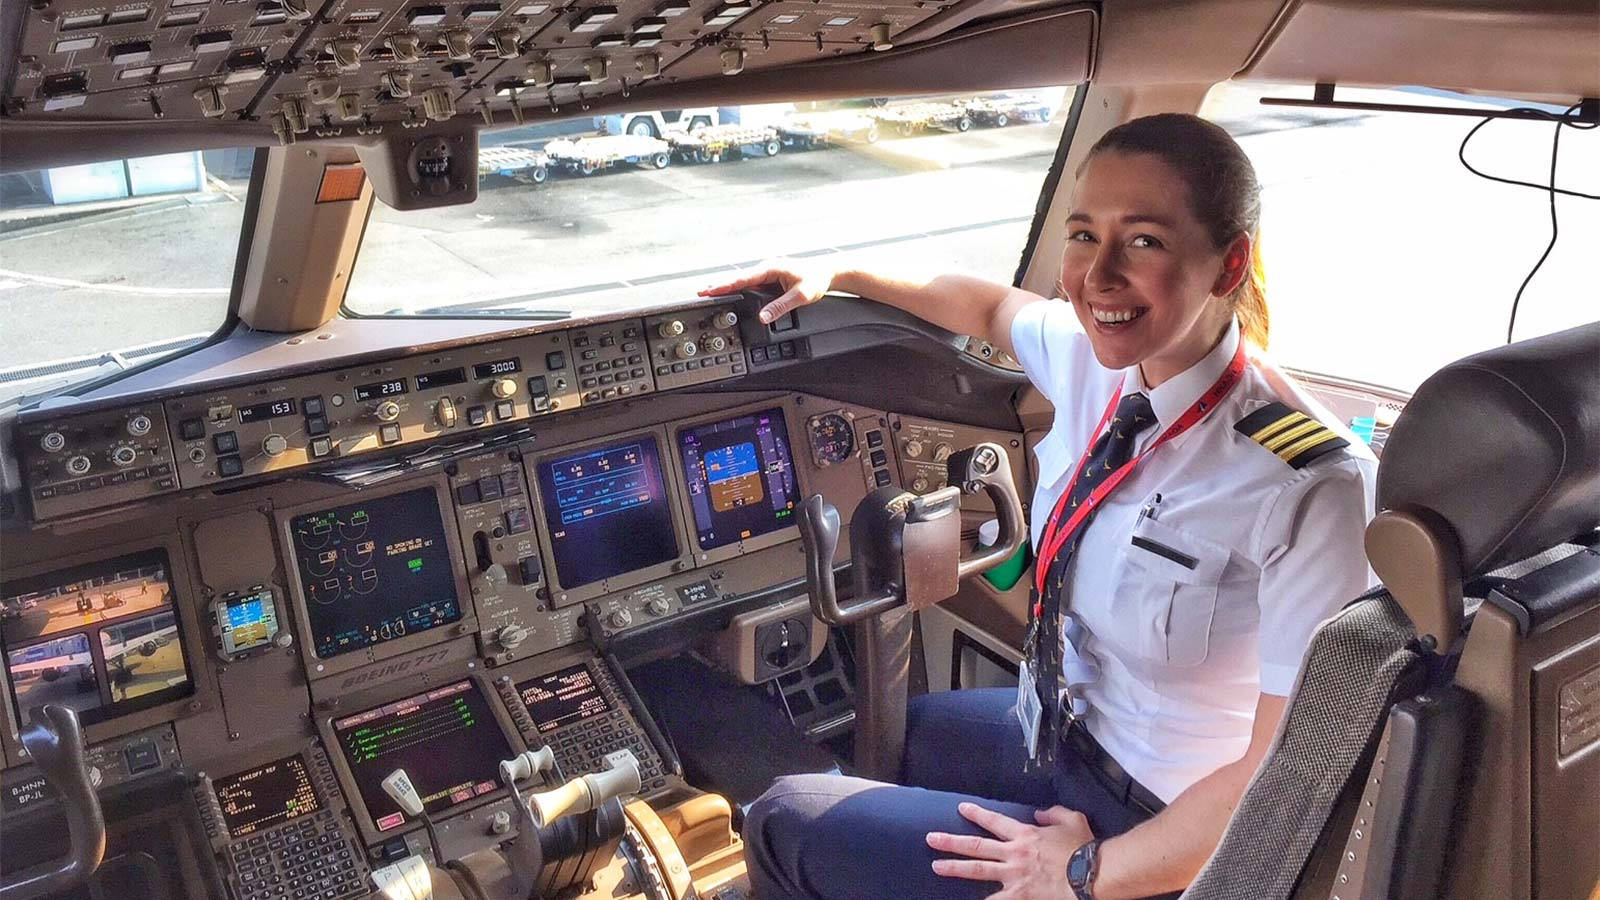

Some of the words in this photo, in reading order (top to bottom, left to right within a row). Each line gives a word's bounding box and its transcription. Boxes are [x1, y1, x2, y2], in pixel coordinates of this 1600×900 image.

[491, 362, 514, 373] 3000
[382, 382, 402, 393] 238
[272, 403, 290, 414] 153
[342, 662, 412, 687] BOEING
[415, 649, 449, 665] 777
[612, 753, 627, 761] FLAP
[239, 771, 262, 782] TAKEOFF
[12, 779, 46, 795] B-HNN
[422, 791, 448, 803] CHECKLIST
[450, 782, 473, 794] COMPLETE
[18, 791, 44, 804] BP-JL
